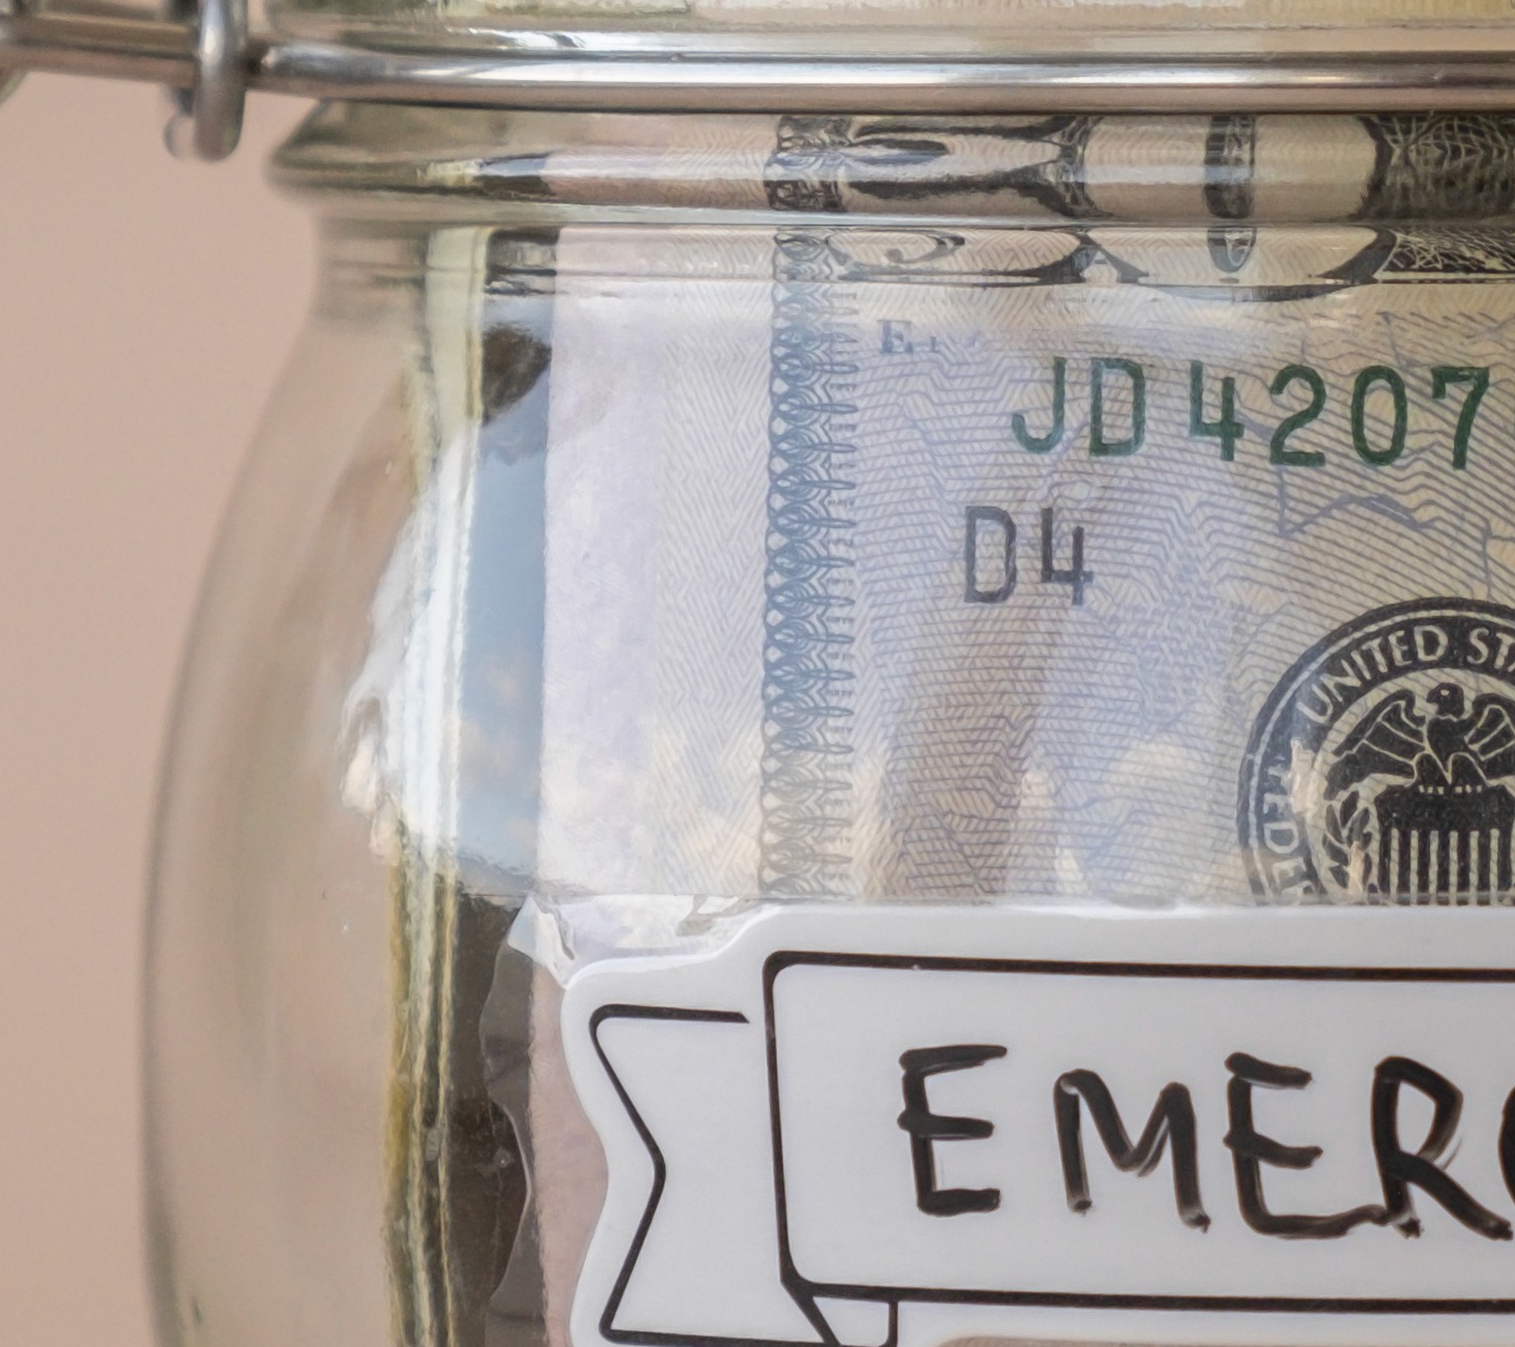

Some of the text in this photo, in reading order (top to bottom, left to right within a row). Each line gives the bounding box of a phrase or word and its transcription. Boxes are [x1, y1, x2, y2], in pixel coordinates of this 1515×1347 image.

[1011, 357, 1146, 456] JD
[965, 506, 1094, 605] D4
[1296, 624, 1449, 723] UNITED
